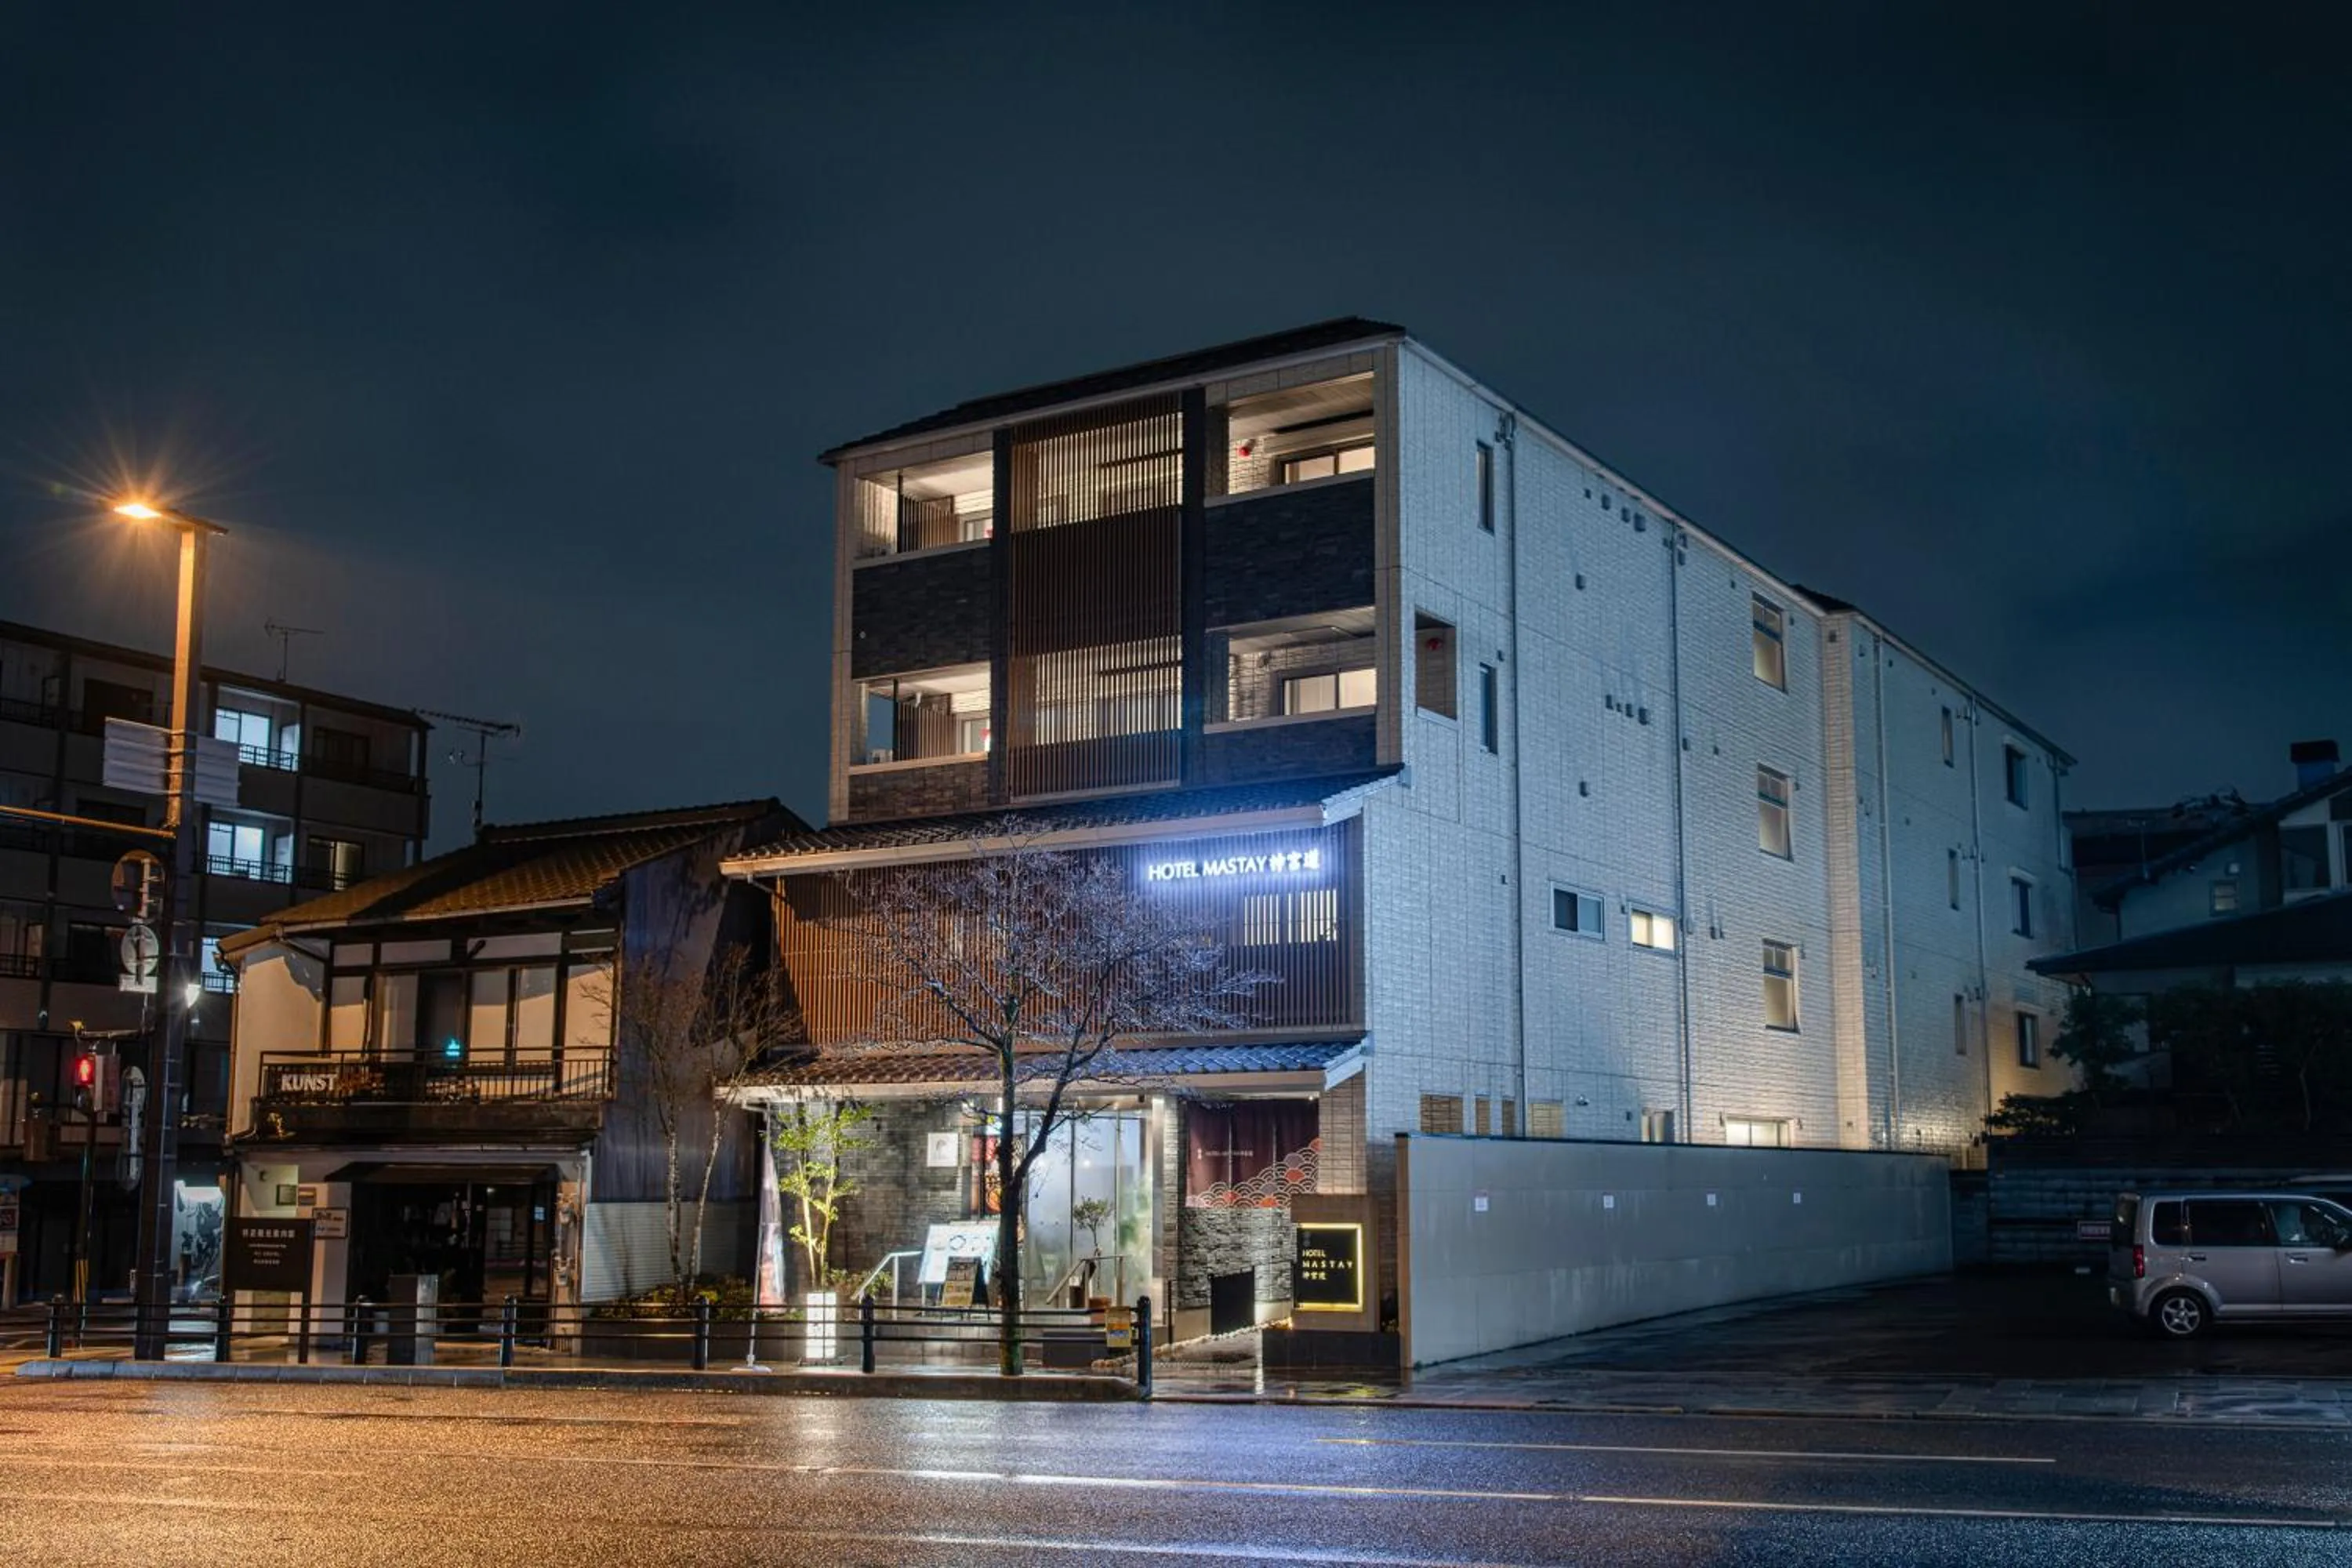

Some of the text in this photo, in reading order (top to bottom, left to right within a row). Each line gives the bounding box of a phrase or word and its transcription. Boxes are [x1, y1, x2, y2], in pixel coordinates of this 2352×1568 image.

[1149, 862, 1200, 881] HOTEL
[1202, 855, 1267, 877] MASTAY
[281, 1073, 337, 1091] KUNST
[1302, 1260, 1353, 1269] MASTAY
